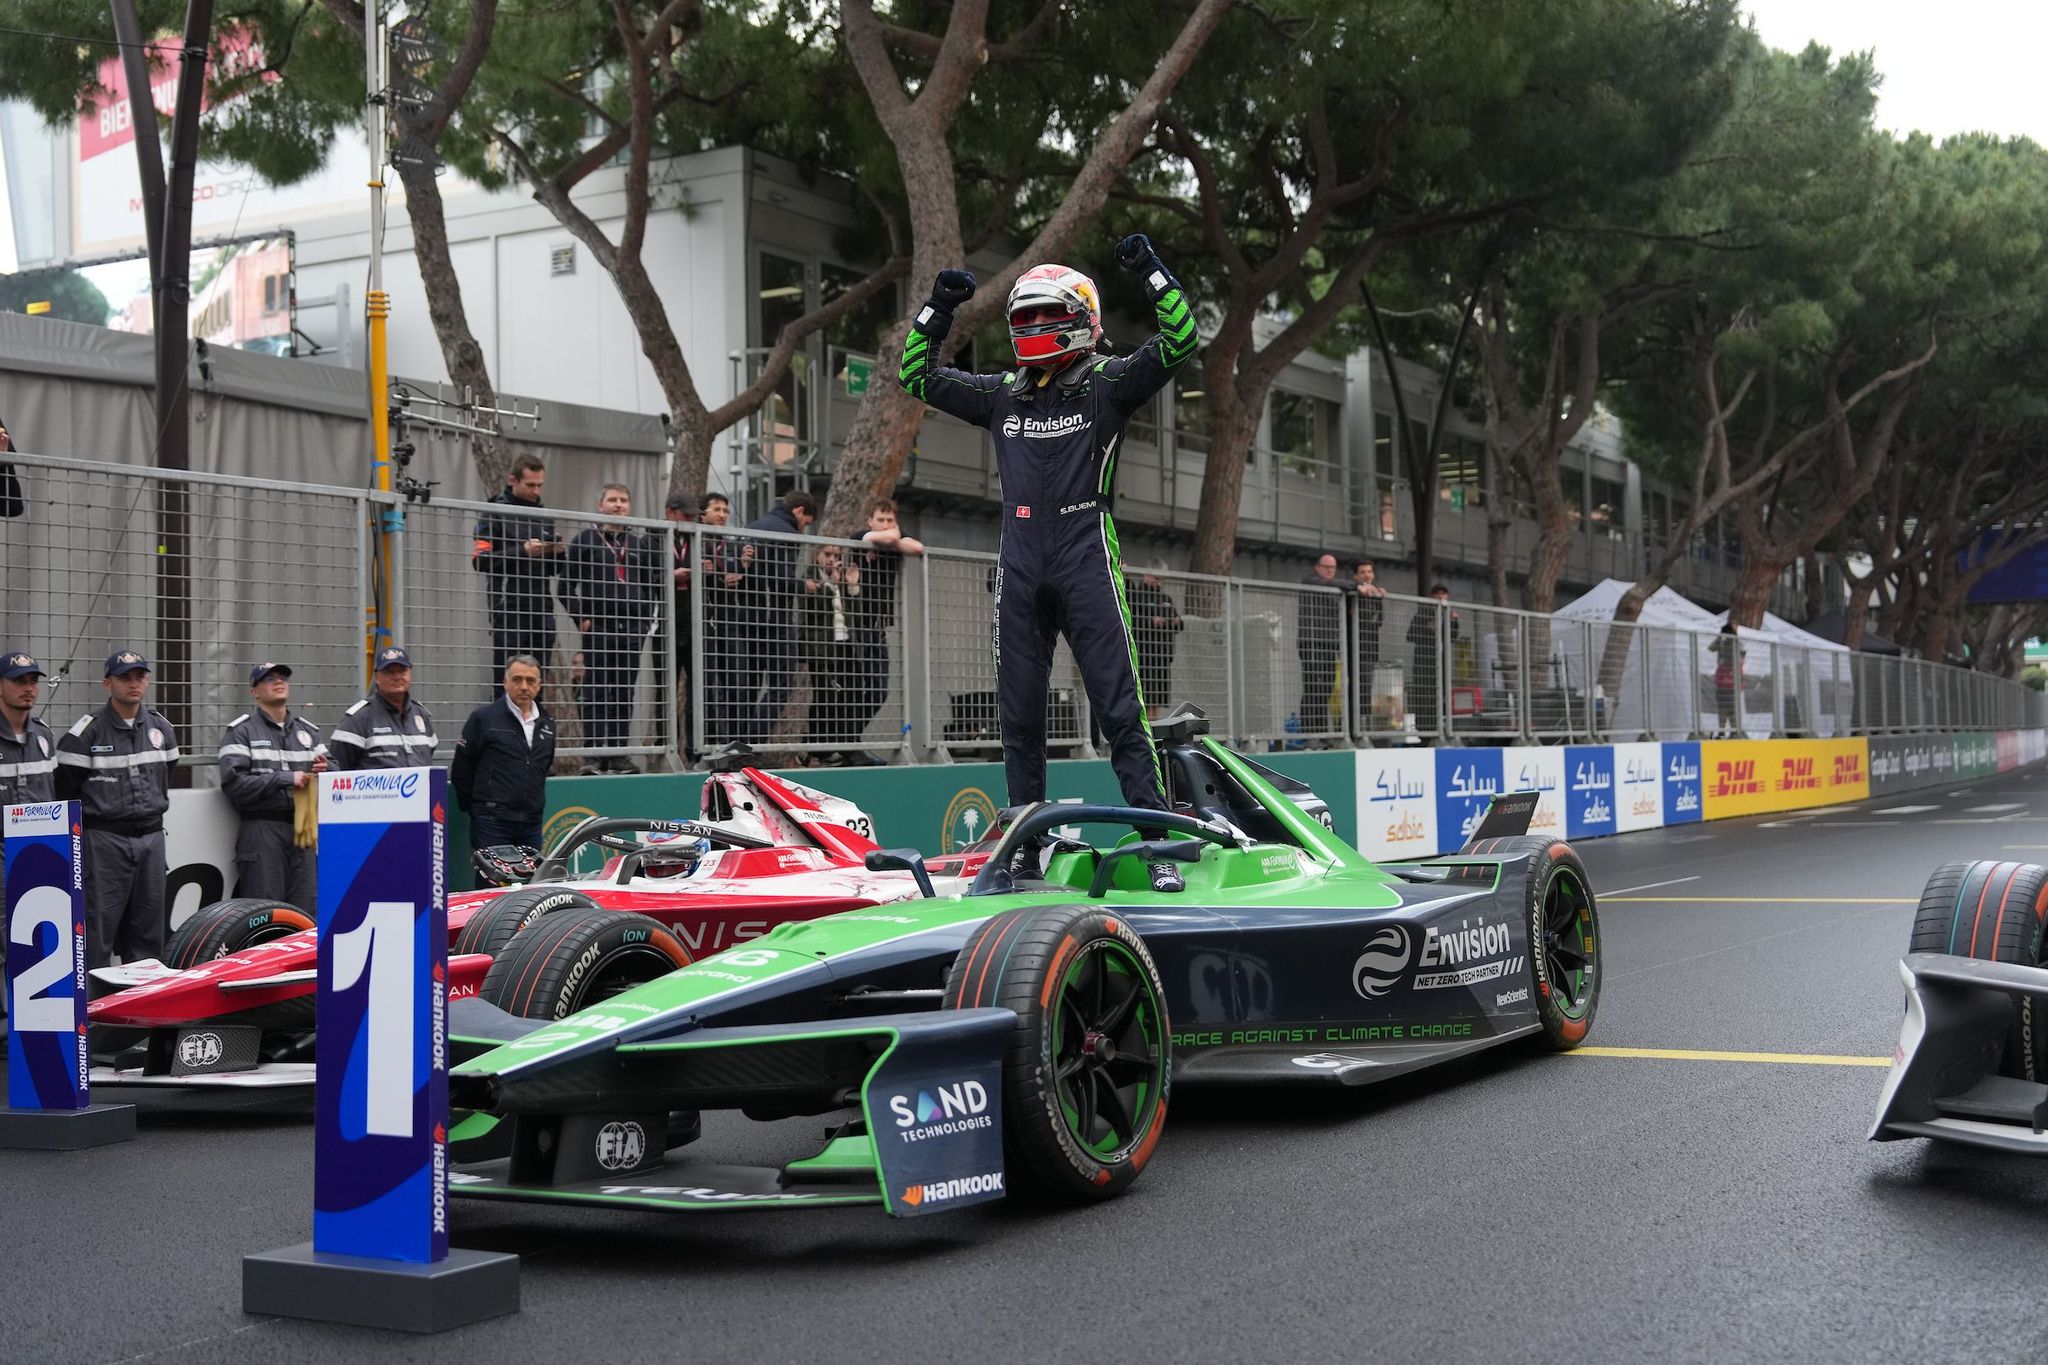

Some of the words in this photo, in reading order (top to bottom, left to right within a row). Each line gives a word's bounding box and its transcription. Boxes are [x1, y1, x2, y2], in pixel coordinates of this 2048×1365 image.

[1023, 413, 1083, 432] Envision
[332, 777, 352, 790] ABB
[1714, 759, 1758, 797] DHL
[1779, 757, 1816, 790] DHL
[1832, 754, 1861, 785] DHL
[1583, 796, 1611, 824] sabic
[649, 820, 713, 837] NISSAN
[1386, 810, 1425, 842] sabic
[1418, 916, 1511, 967] Envision
[10, 885, 75, 1032] 2
[1417, 975, 1434, 987] NET
[1438, 974, 1460, 985] ZERO
[1461, 970, 1476, 983] TECH
[1476, 965, 1500, 980] PARTNER
[332, 902, 415, 1138] 1
[1171, 1032, 1223, 1047] RACE
[1231, 1028, 1318, 1045] AGAINST
[1326, 1025, 1404, 1041] CLIMATE
[1410, 1023, 1472, 1038] CHANGE
[900, 1115, 992, 1143] TECHNOLOGIES
